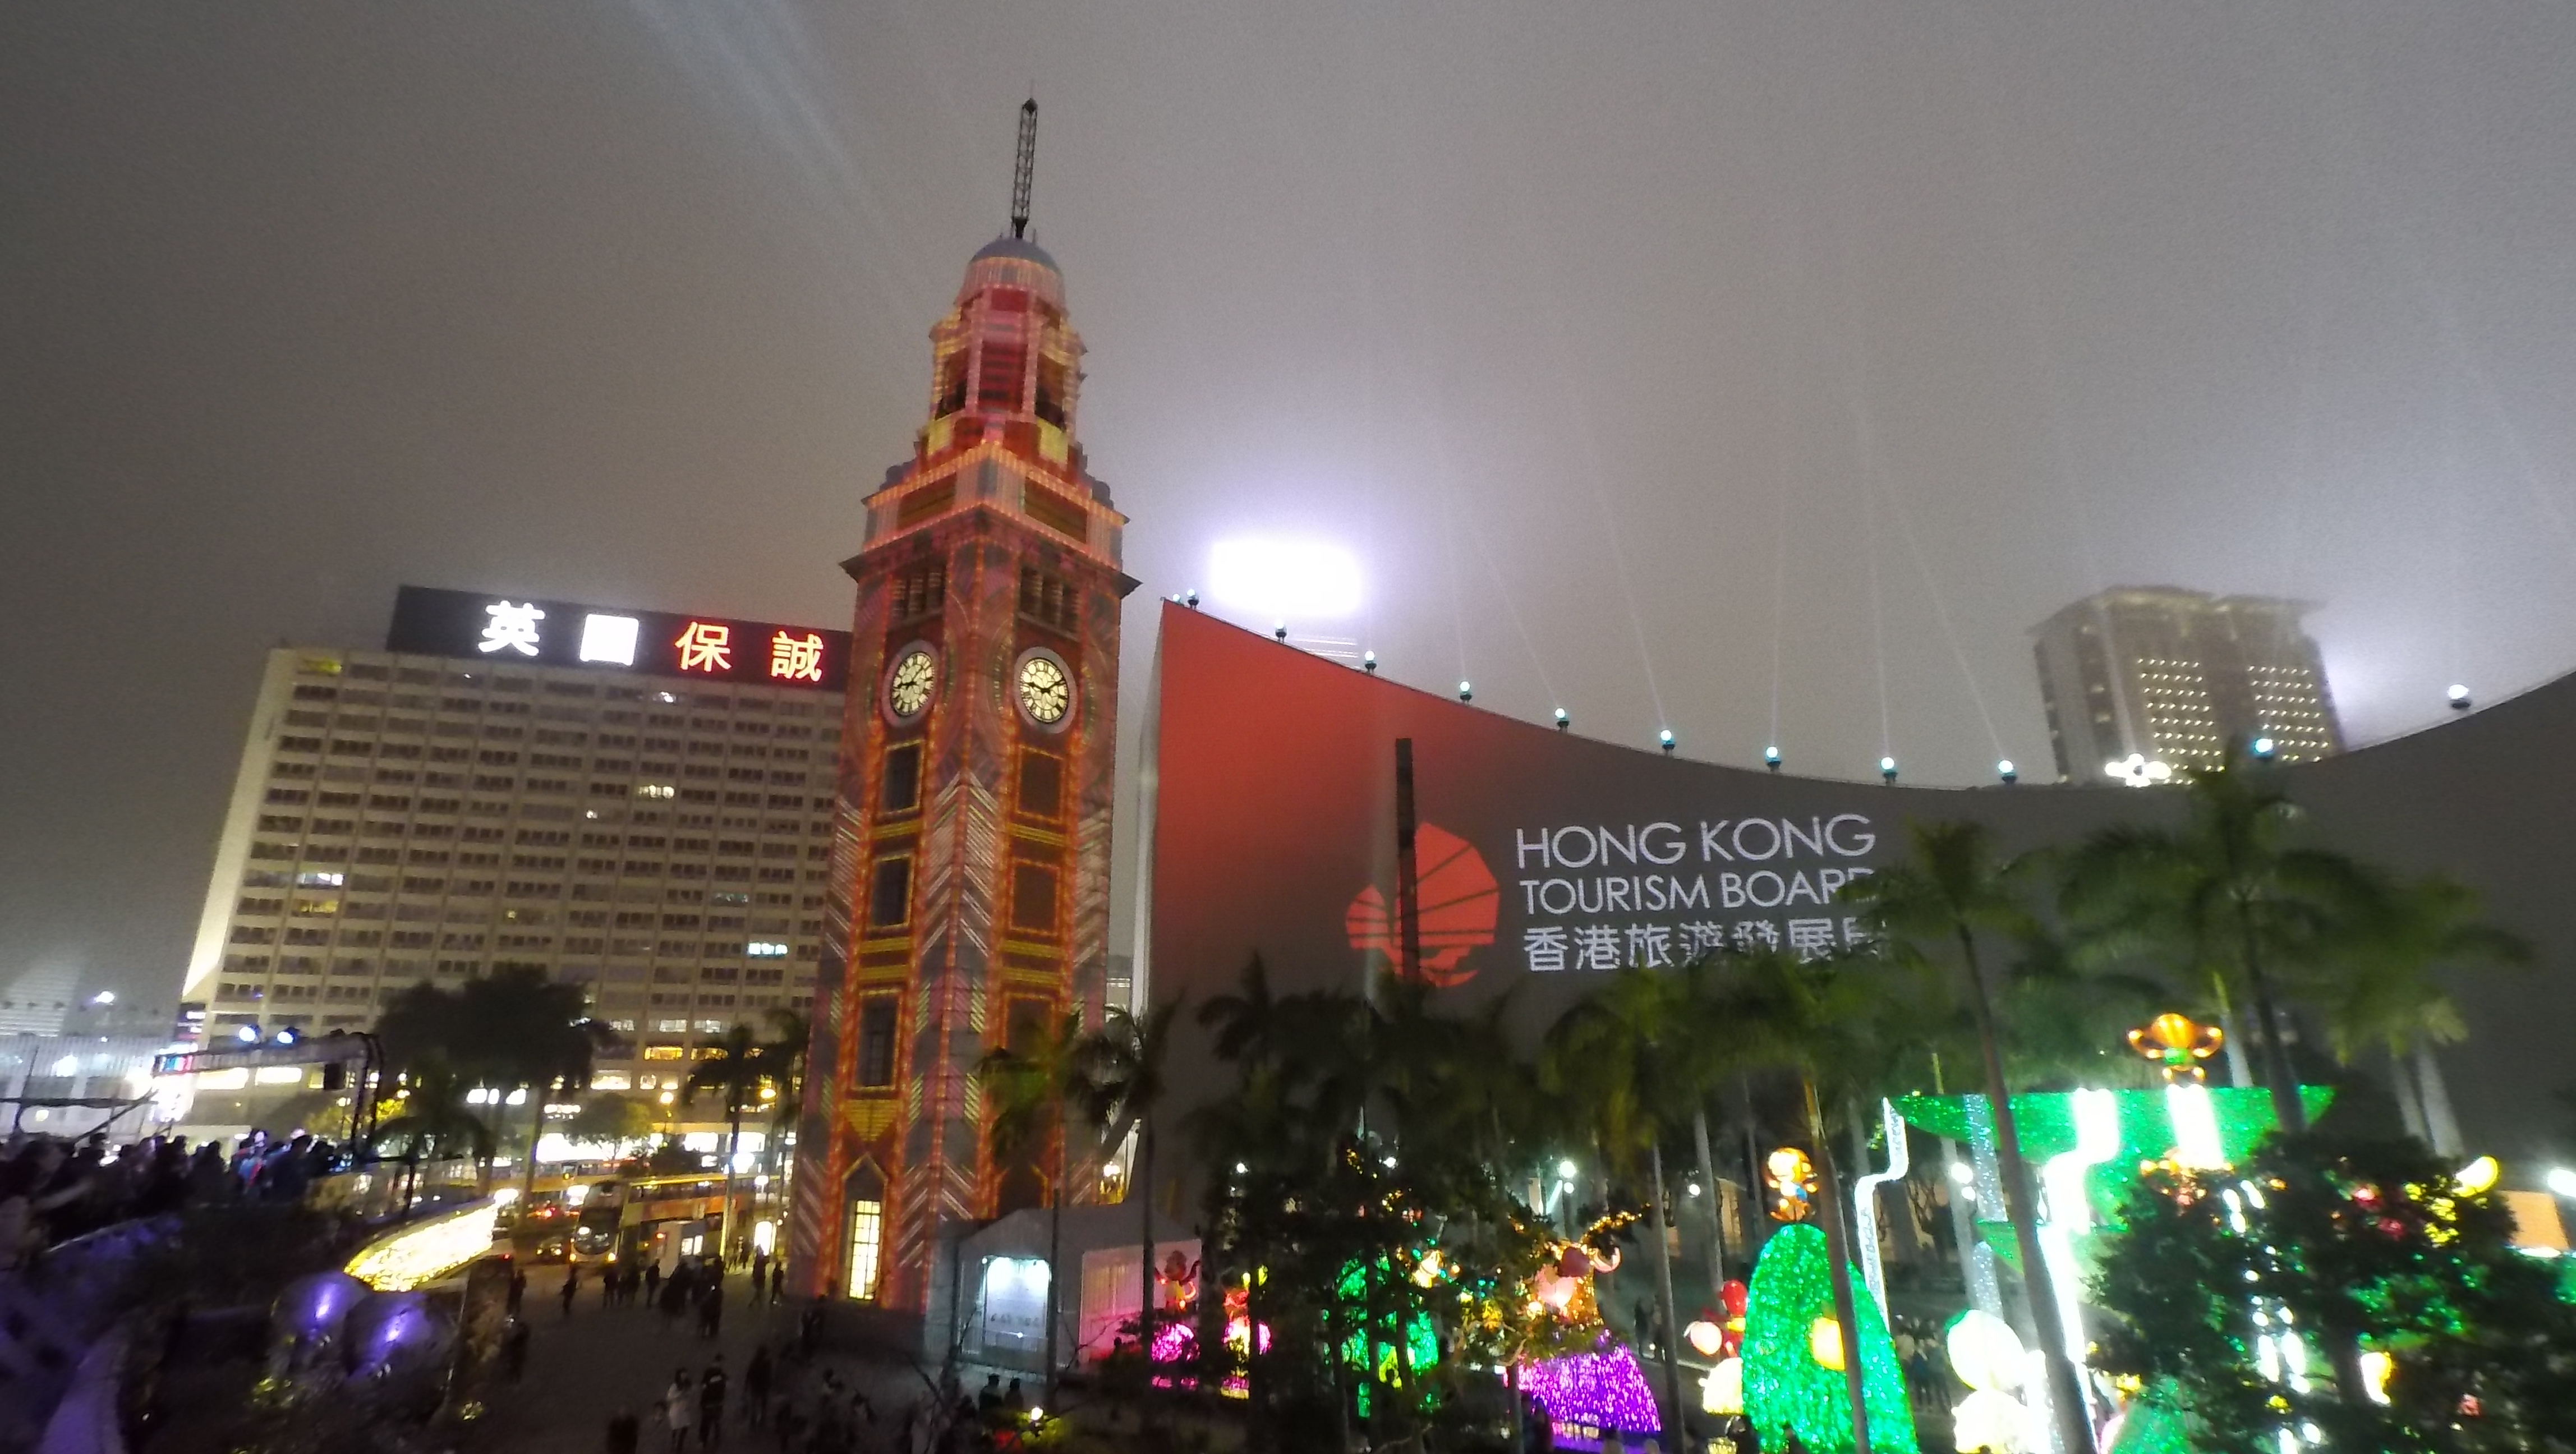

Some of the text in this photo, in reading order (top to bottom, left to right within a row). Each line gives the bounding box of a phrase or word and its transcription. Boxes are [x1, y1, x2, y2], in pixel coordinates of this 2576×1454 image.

[1516, 813, 1876, 869] HONG KONG
[1519, 874, 1711, 915] TOURISM
